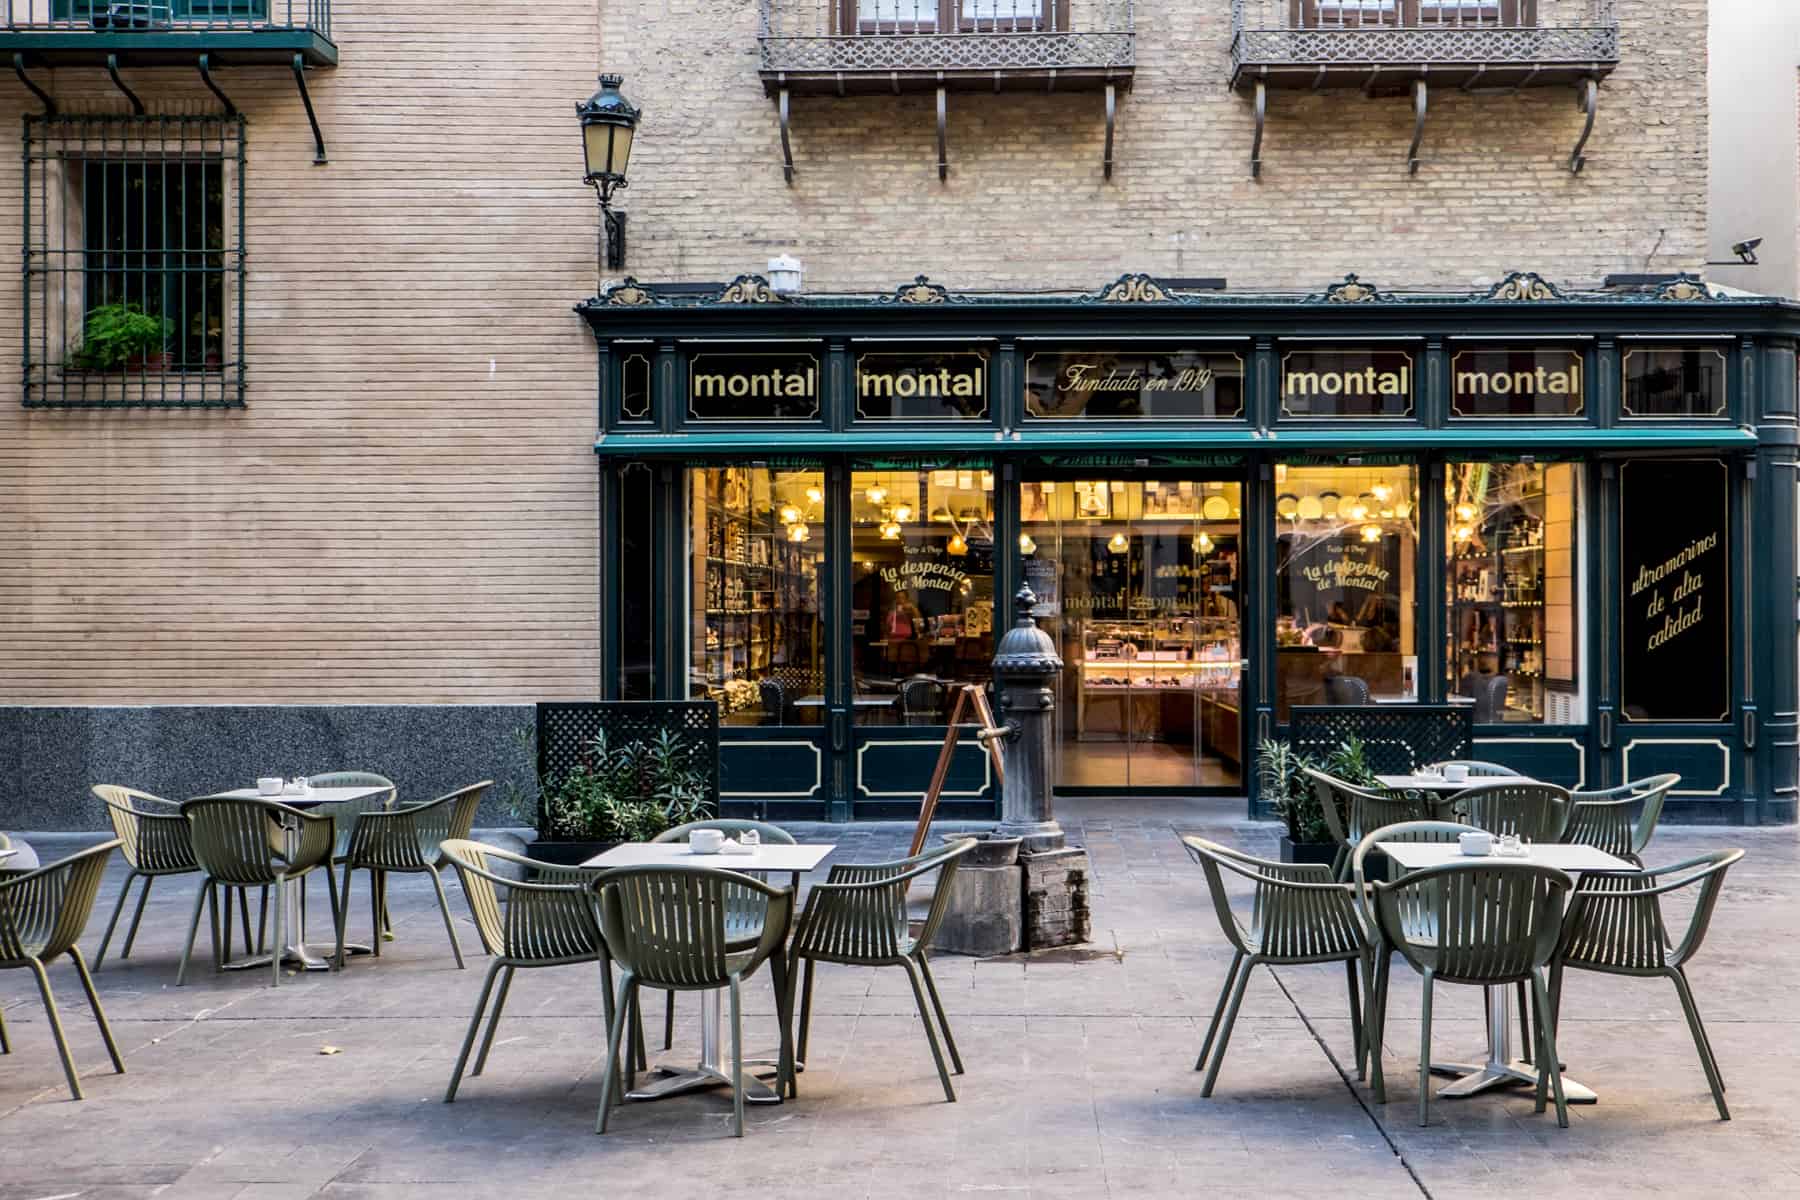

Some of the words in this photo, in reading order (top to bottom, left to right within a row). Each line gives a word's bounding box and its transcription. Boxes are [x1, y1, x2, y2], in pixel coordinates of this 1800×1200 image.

[694, 367, 815, 397] montal
[862, 367, 982, 397] montal
[1058, 364, 1140, 392] Fundada
[1143, 378, 1170, 392] en
[1172, 368, 1212, 392] 1919
[1287, 366, 1408, 396] montal
[1457, 365, 1578, 395] montal
[880, 567, 898, 582] La
[900, 561, 966, 581] despensa
[1303, 566, 1321, 582] La
[1323, 560, 1391, 581] despensa
[1630, 531, 1717, 597] ultramarinos
[893, 579, 908, 592] de
[911, 575, 955, 592] Montal
[1316, 579, 1331, 592] de
[1335, 574, 1379, 592] Montal
[1646, 589, 1665, 619] de
[1672, 569, 1704, 604] alta
[1647, 595, 1704, 653] calidad
